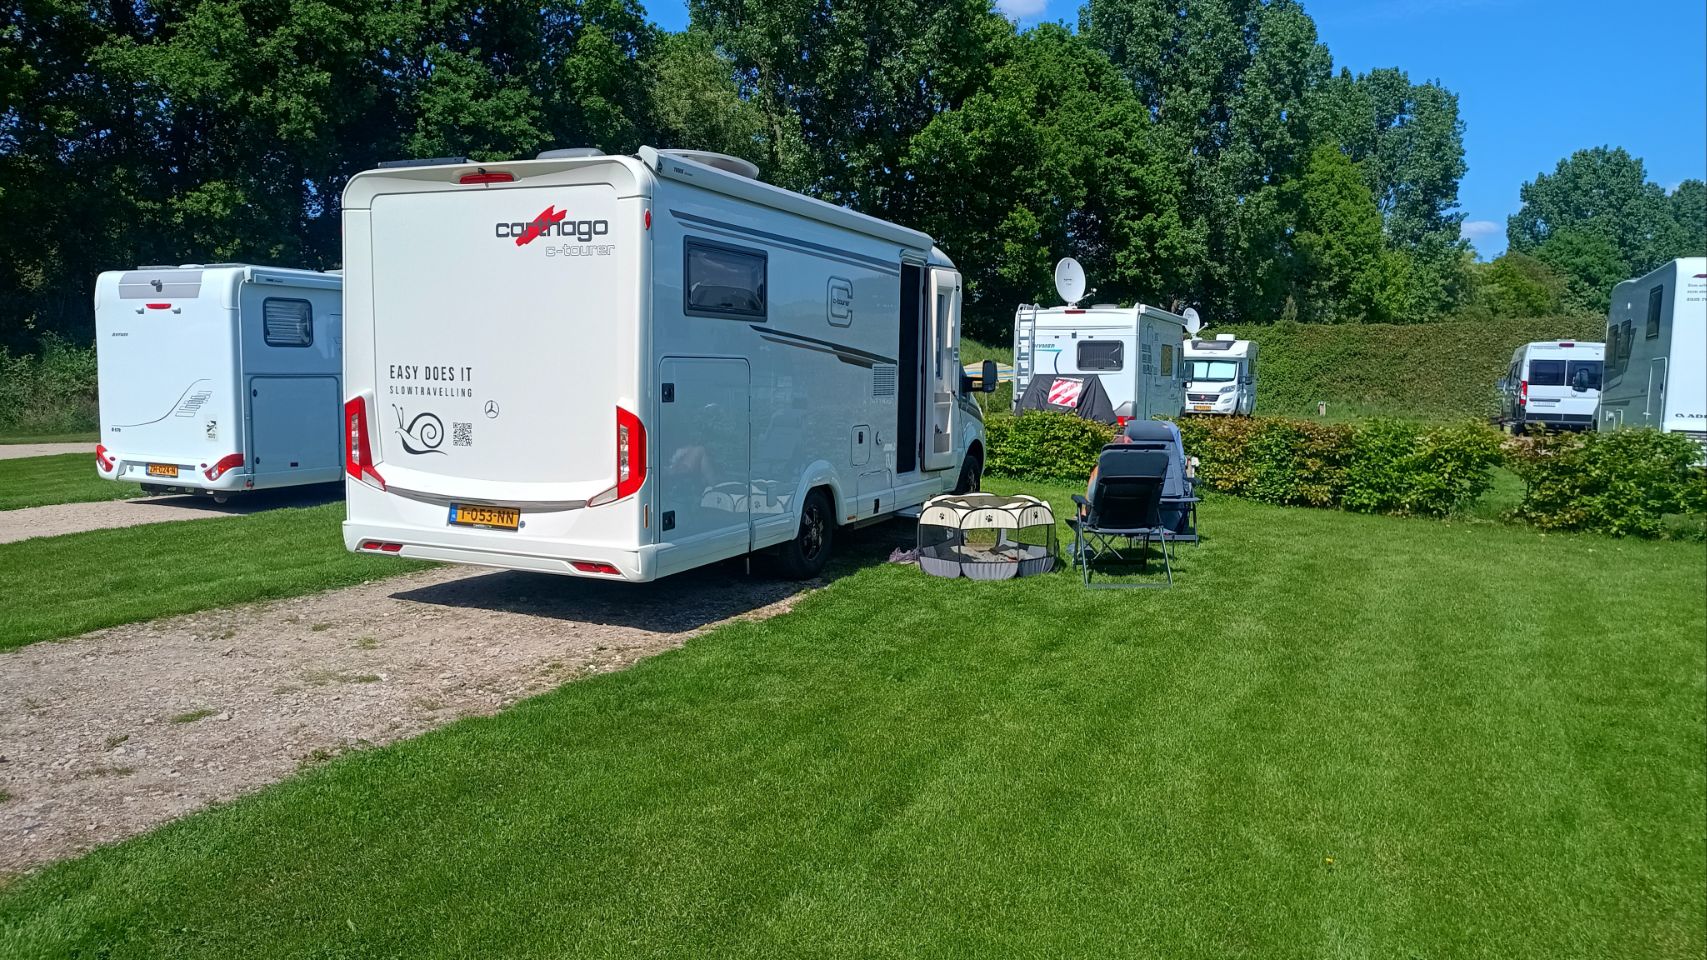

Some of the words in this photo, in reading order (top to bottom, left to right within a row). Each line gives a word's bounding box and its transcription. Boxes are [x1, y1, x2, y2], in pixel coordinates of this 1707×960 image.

[495, 216, 609, 242] carthago
[545, 243, 616, 257] c-tourer
[389, 364, 419, 380] EASY
[424, 366, 455, 382] DOES
[460, 366, 472, 382] IT
[389, 385, 472, 398] SLOWTRAVELLING
[459, 507, 515, 525] T-053-NN
